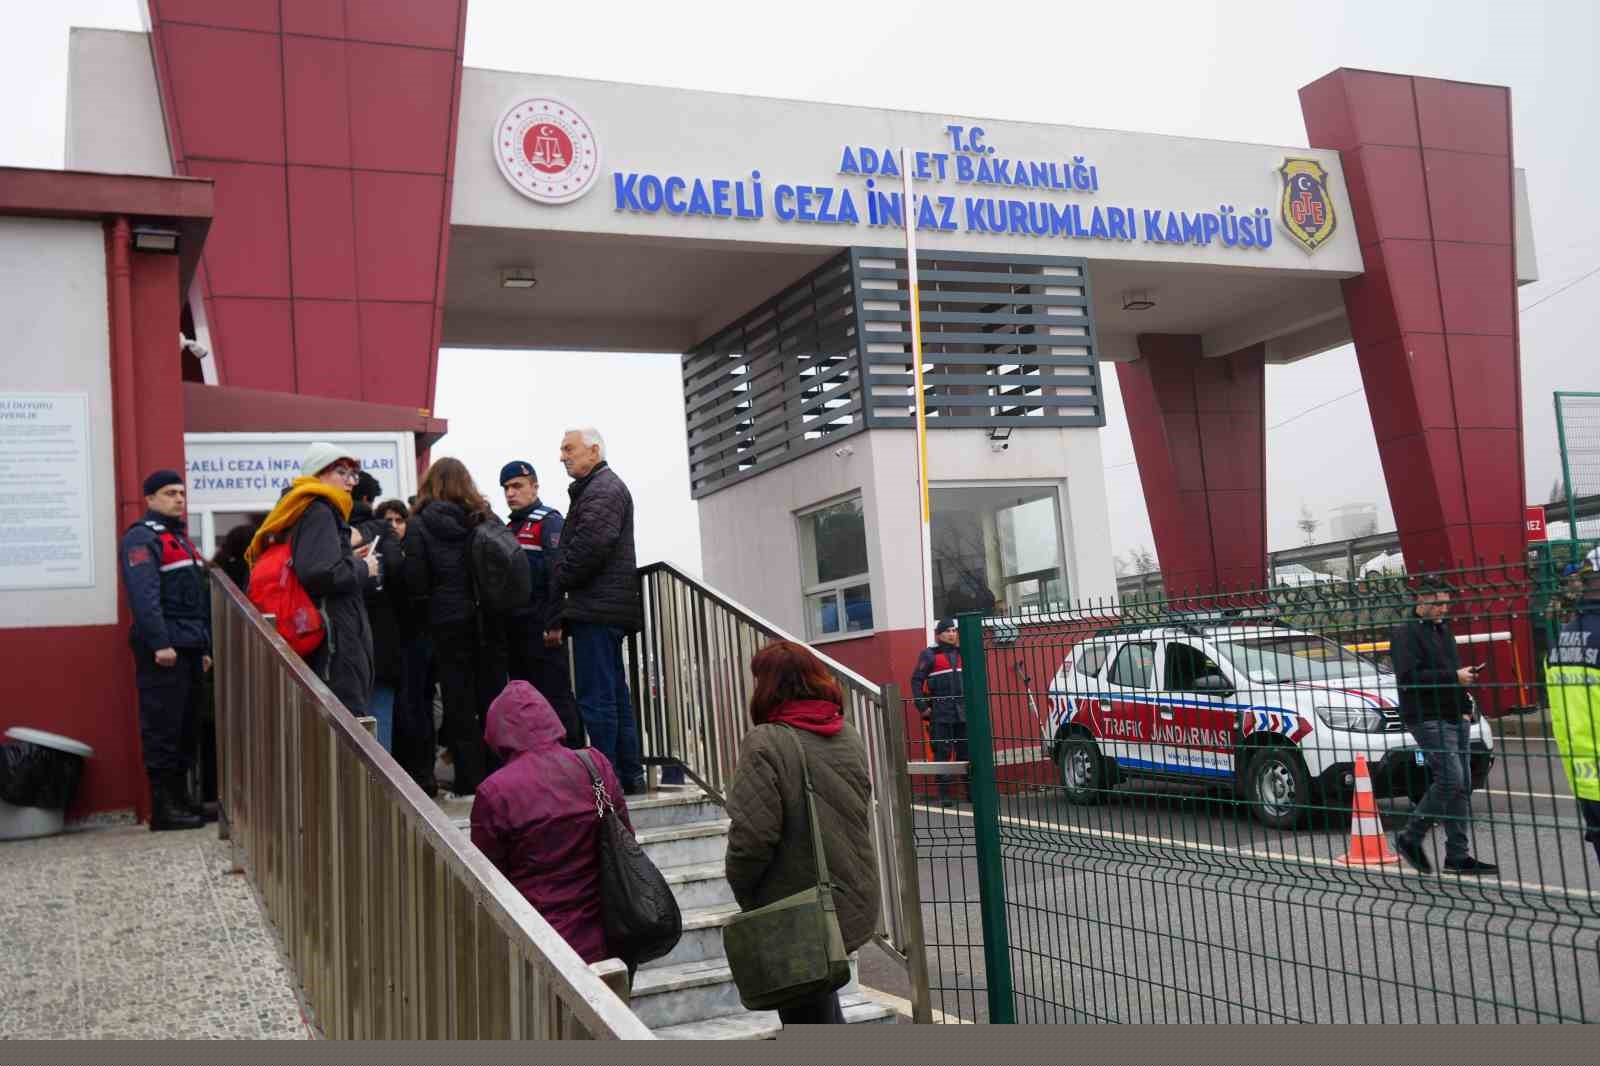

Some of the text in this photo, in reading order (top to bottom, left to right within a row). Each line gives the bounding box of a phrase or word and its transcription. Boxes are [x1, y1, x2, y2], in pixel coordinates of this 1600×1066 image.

[948, 125, 995, 154] T.C.
[956, 155, 1098, 191] BAKANLIĞI
[614, 170, 1273, 249] KOCAELİ CEZA İNAZ KURUMLARI KAMPÜSÜ
[185, 456, 224, 471] CAELİ
[228, 459, 265, 471] CEZA
[268, 456, 301, 470] İNFA
[194, 475, 267, 491] ZİYARETÇİ
